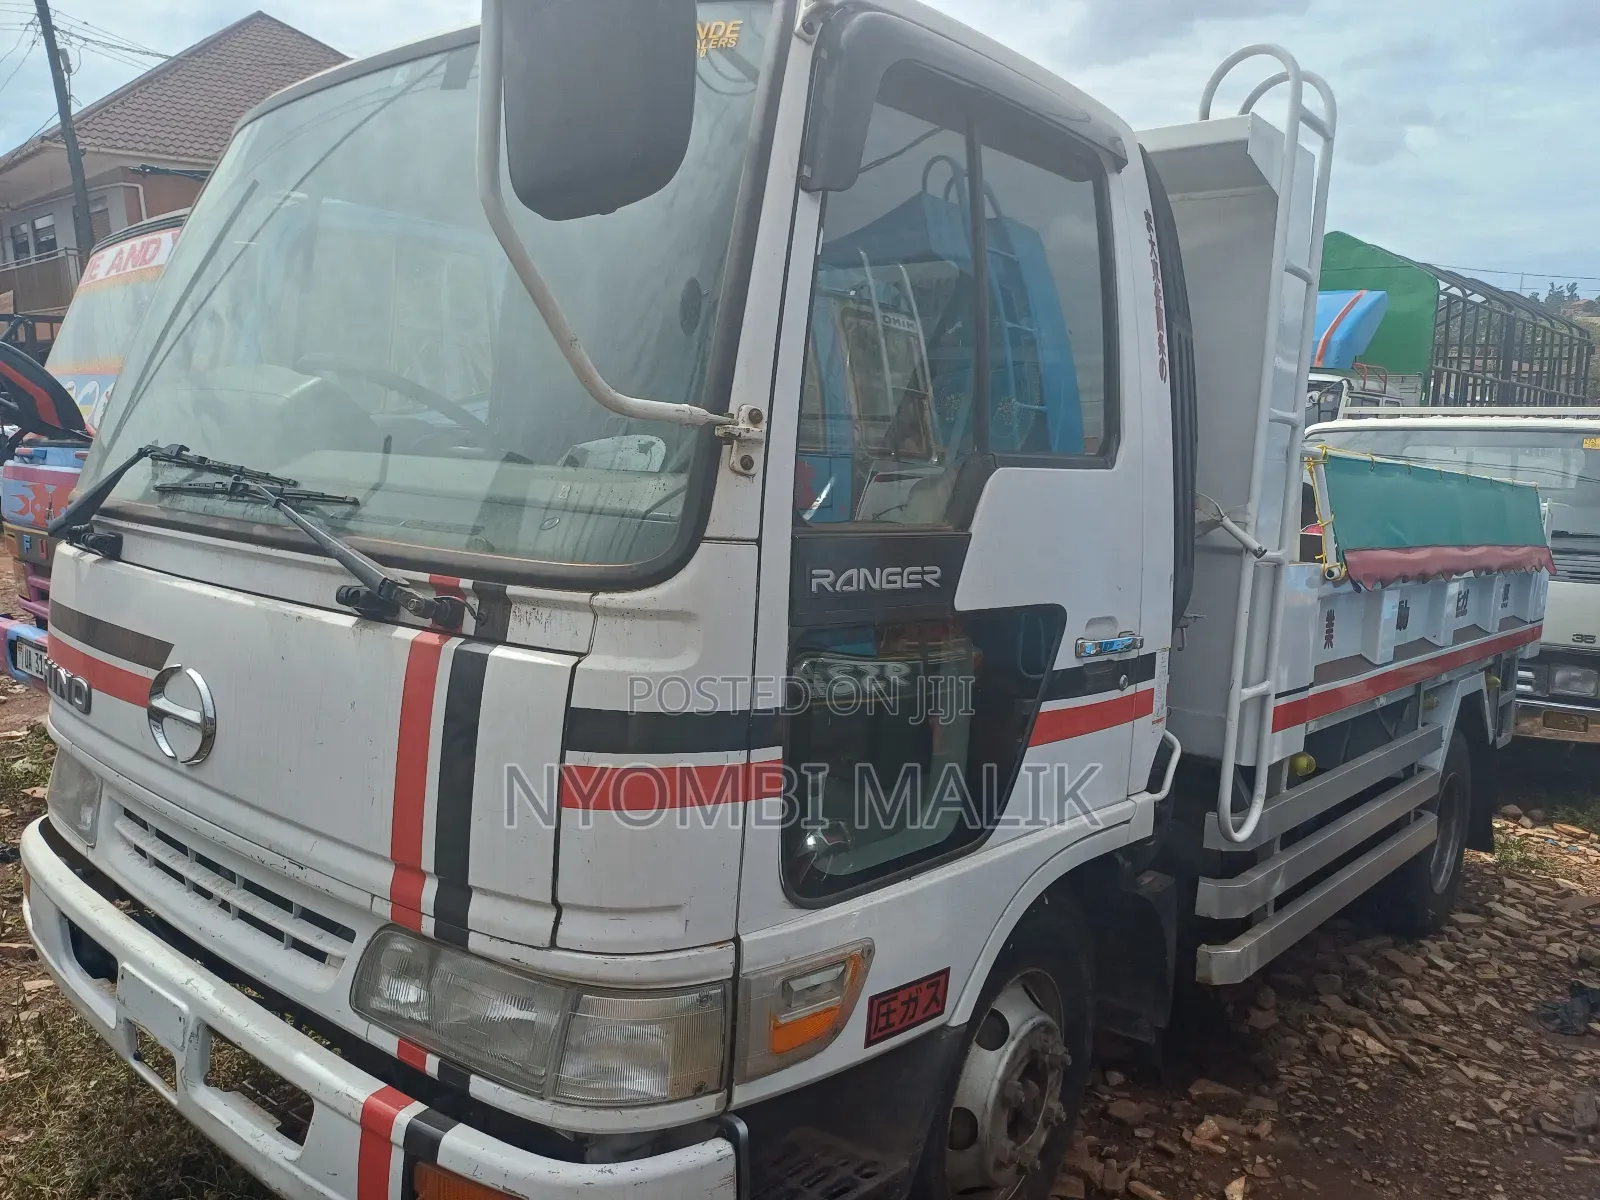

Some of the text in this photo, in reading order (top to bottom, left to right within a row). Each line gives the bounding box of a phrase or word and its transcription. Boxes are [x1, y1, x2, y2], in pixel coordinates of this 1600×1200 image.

[696, 20, 742, 39] NDE
[105, 237, 162, 276] AND
[811, 565, 942, 593] RANGER
[872, 980, 941, 1036] 圧ガス
